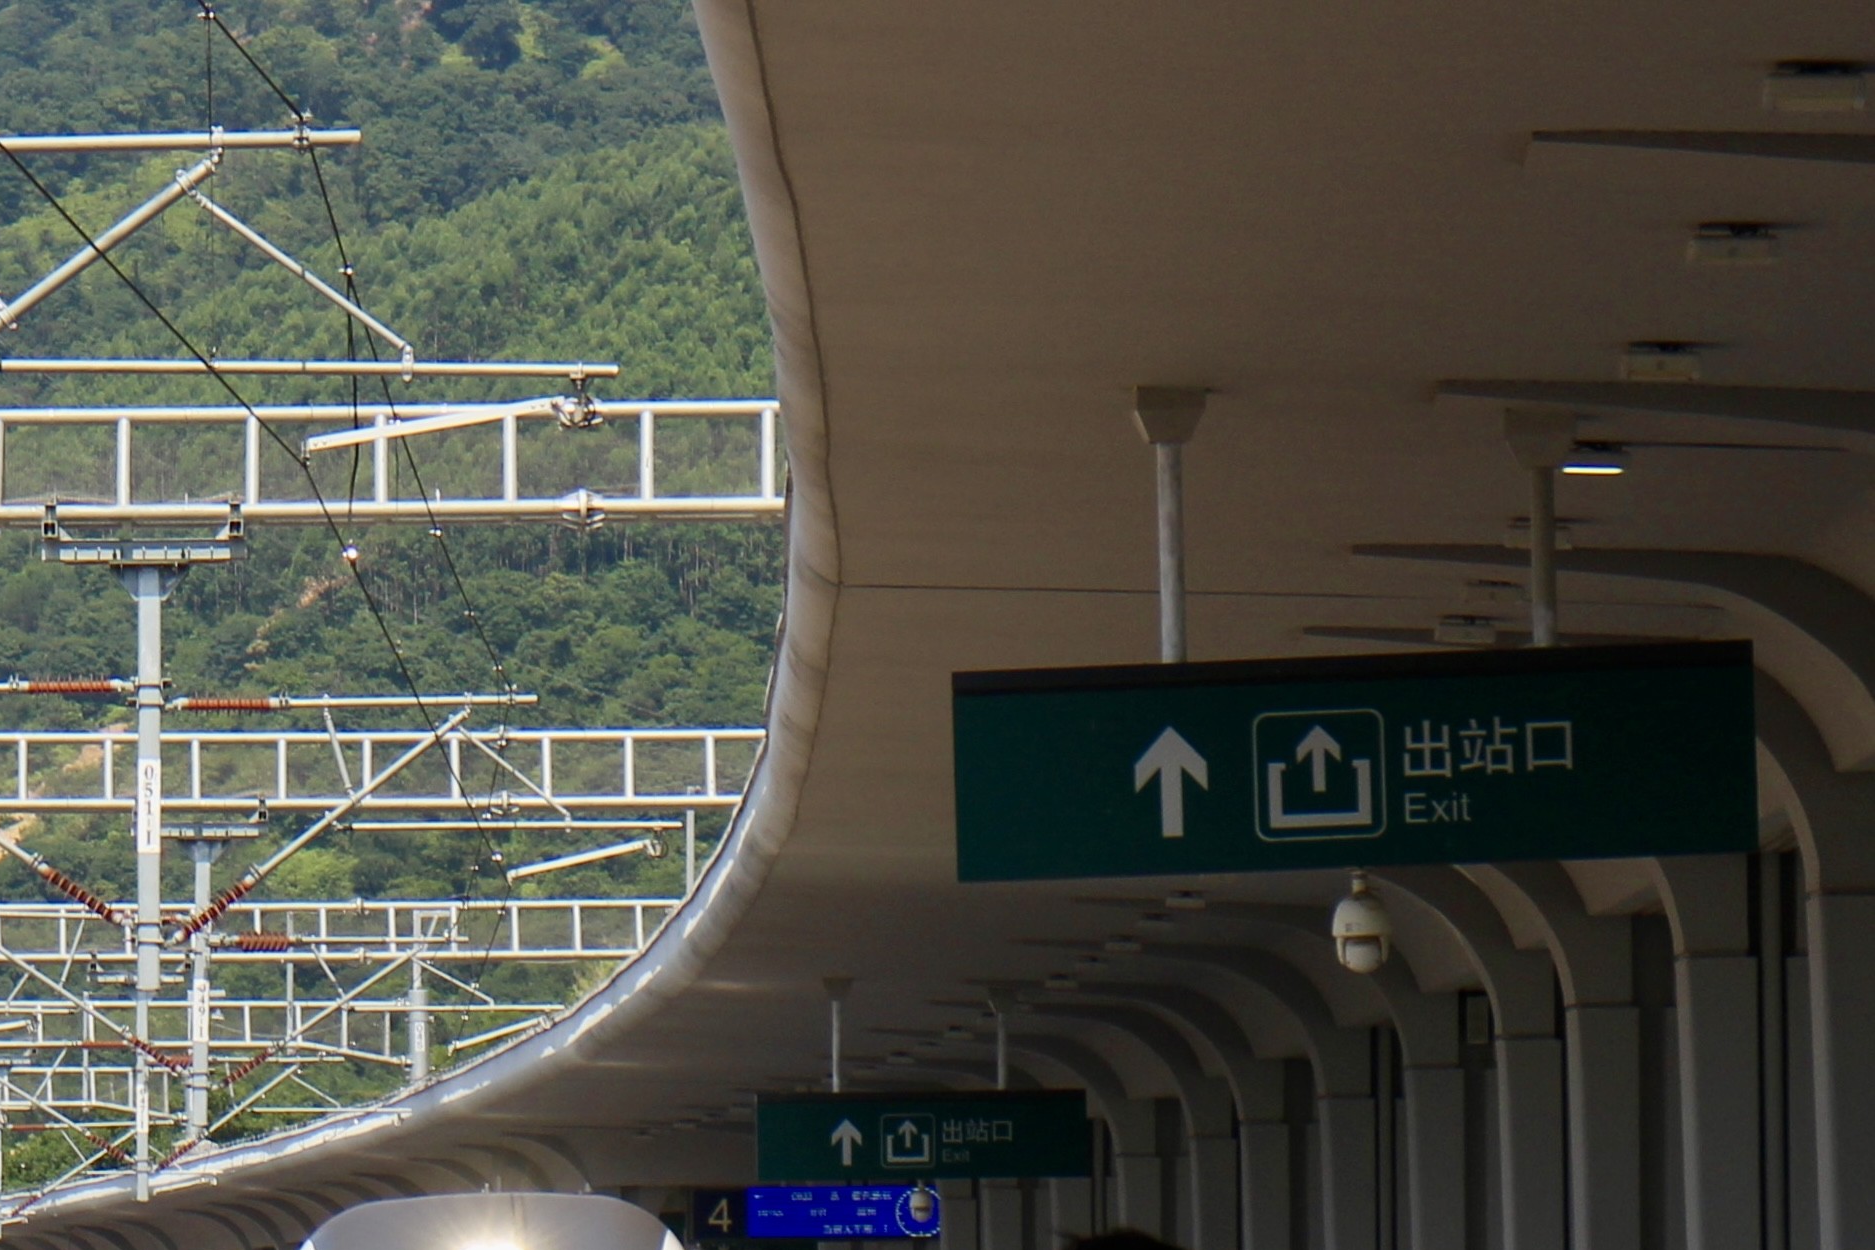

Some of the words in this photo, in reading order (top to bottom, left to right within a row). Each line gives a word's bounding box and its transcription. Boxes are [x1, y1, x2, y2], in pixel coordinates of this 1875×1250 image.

[1400, 716, 1574, 781] 出站口
[1402, 792, 1471, 824] Exit
[942, 1118, 1014, 1144] 出站口
[942, 1149, 970, 1163] Exit
[708, 1198, 732, 1233] 4
